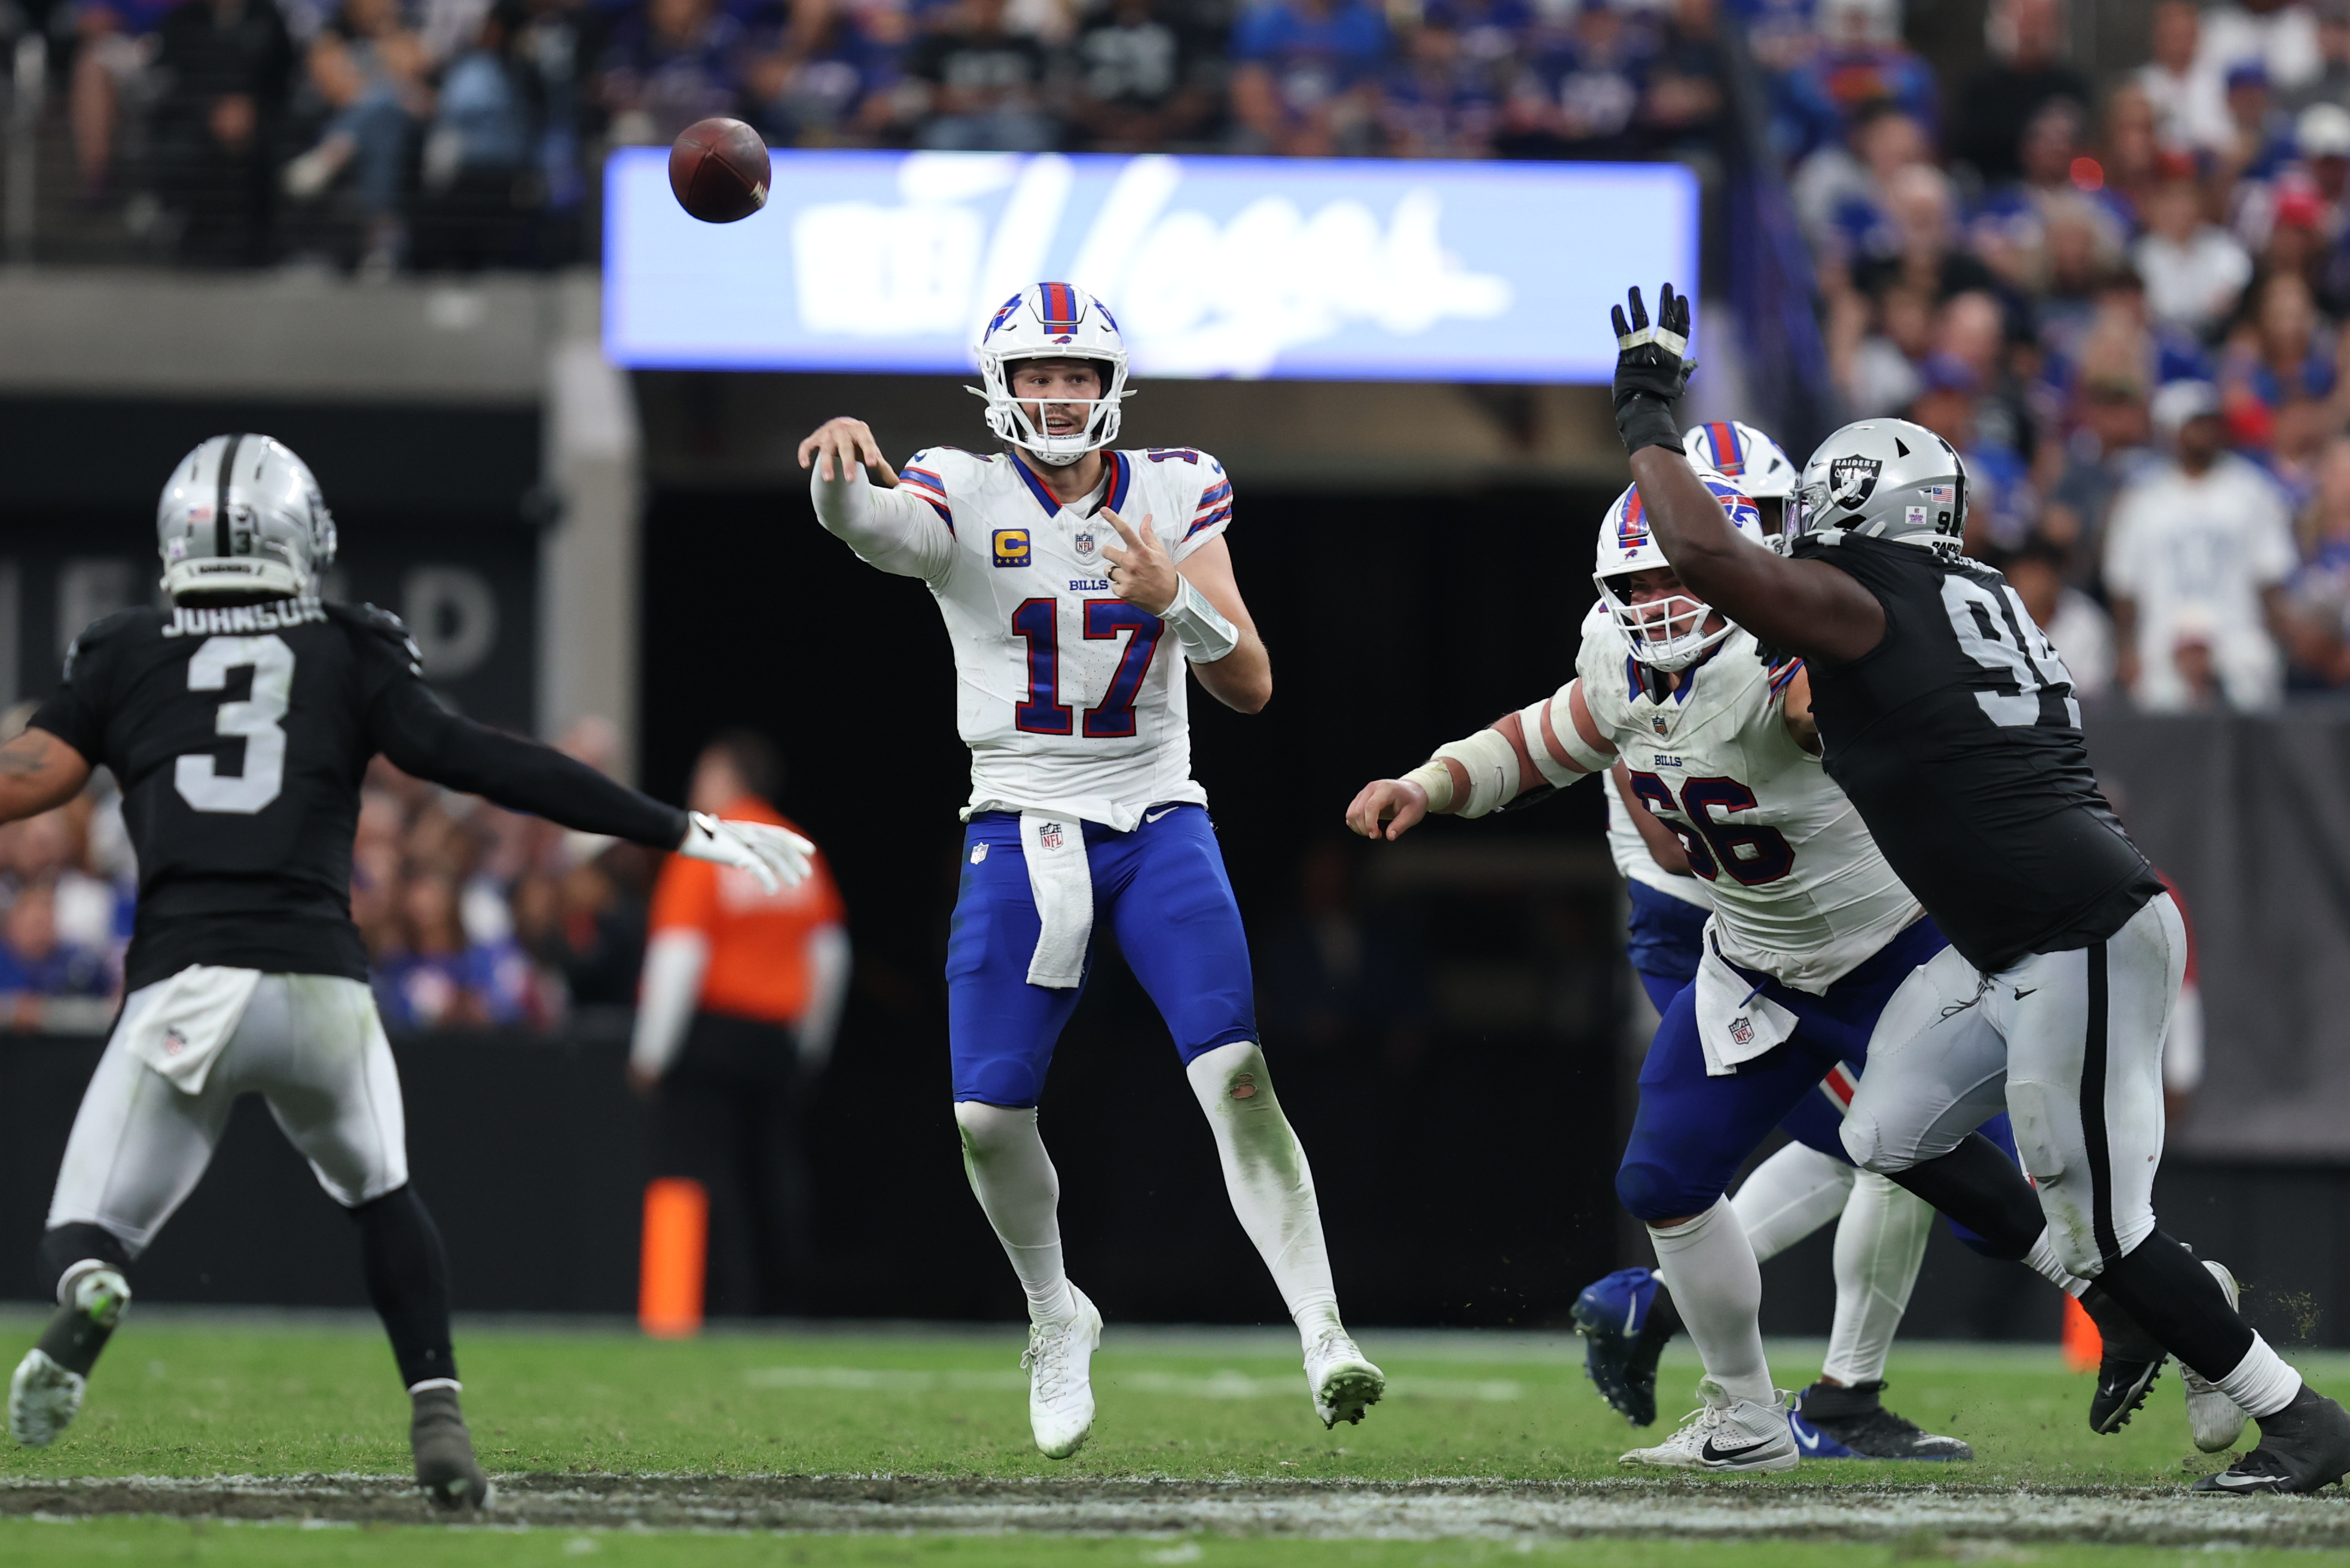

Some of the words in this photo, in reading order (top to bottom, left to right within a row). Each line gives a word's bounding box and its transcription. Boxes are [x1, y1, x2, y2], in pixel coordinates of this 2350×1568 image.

[1835, 459, 1877, 468] RAIDERS
[236, 530, 251, 554] 3
[995, 530, 1028, 557] C
[1078, 541, 1092, 551] NFL
[1069, 579, 1109, 590] BILLS
[161, 596, 328, 637] JOHNSON
[1012, 597, 1165, 738] 17
[174, 634, 295, 814] 3
[1654, 755, 1683, 767] BILLS
[1630, 770, 1796, 886] 66
[1043, 834, 1062, 848] NFL
[1734, 1027, 1752, 1042] NFL
